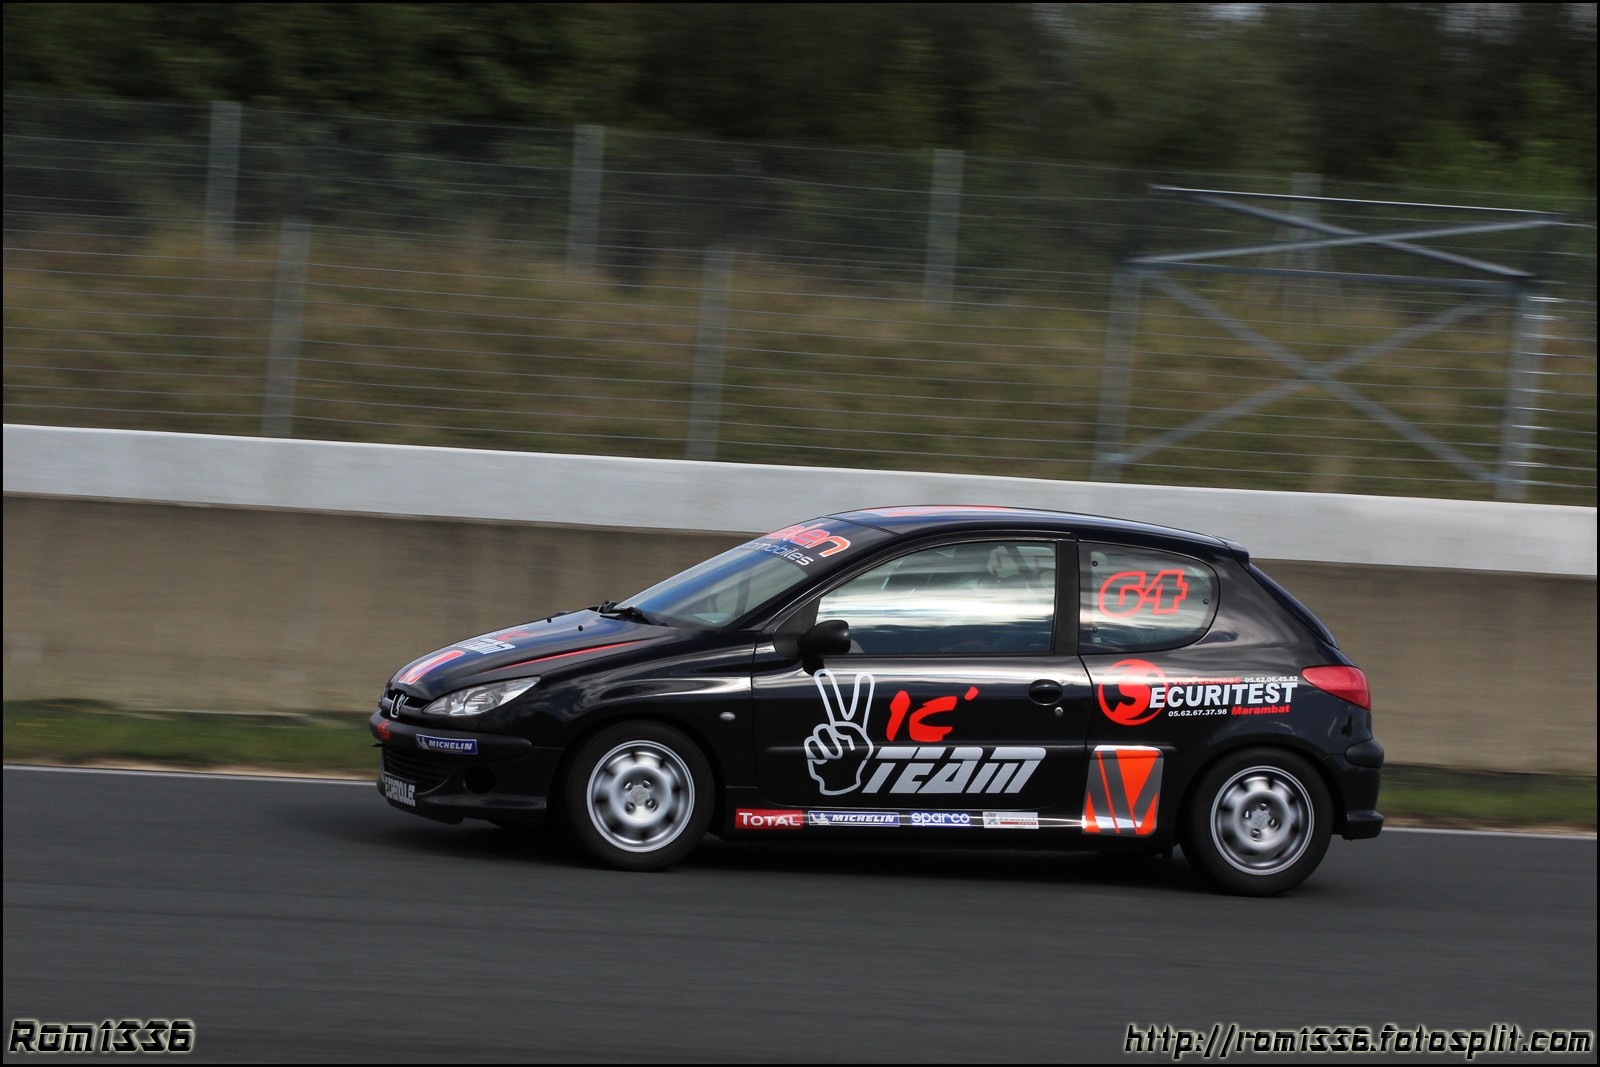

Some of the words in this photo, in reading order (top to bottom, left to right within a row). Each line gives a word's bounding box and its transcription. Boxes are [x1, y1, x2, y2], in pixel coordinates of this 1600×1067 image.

[1098, 569, 1188, 618] 64
[1245, 675, 1299, 683] 05.62.06.45.82
[1168, 708, 1228, 718] 05.62.67.37.98
[1231, 704, 1291, 716] Marambat
[428, 740, 473, 751] MICHELIN
[861, 746, 1047, 794] TEAM
[831, 814, 895, 823] MICHELIN
[911, 812, 971, 827] sparco
